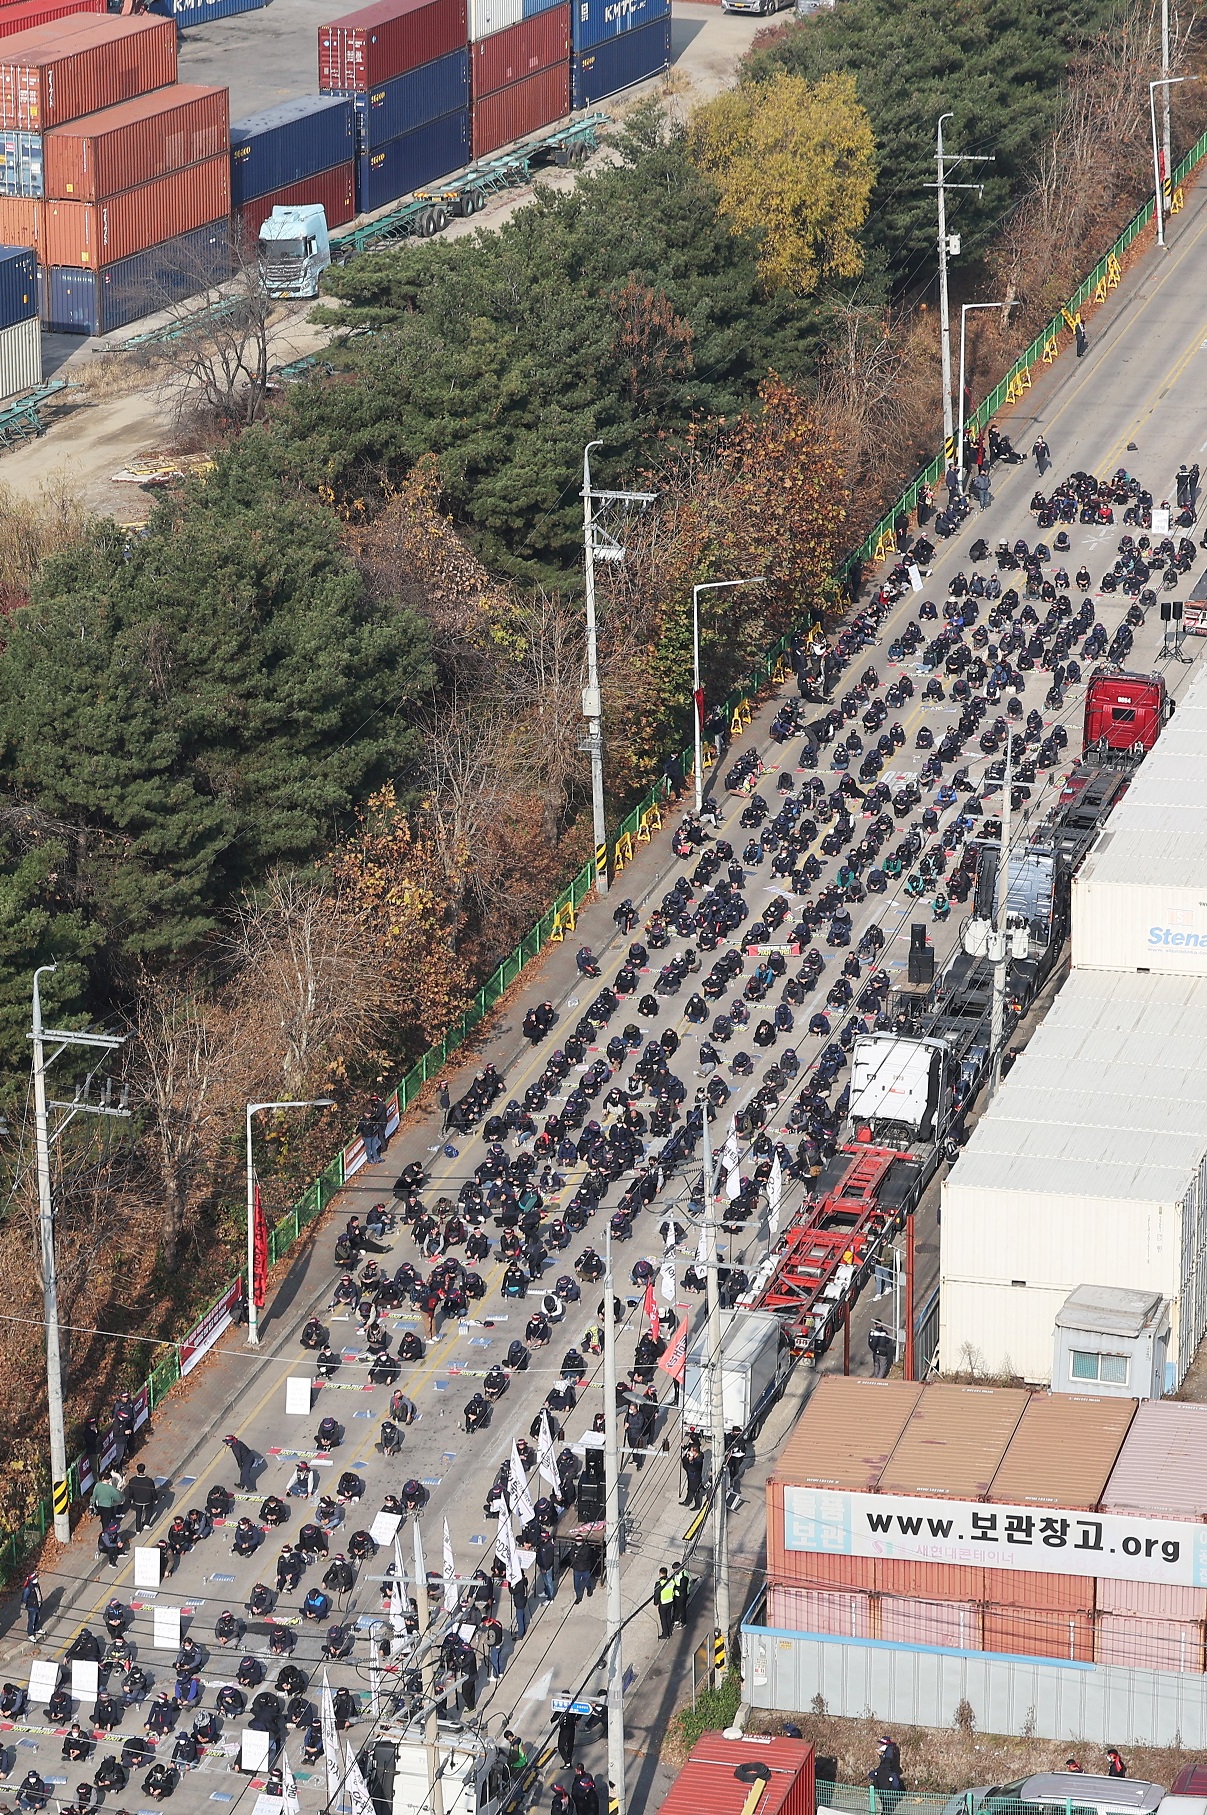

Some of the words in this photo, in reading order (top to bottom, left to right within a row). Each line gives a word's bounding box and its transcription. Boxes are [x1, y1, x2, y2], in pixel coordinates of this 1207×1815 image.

[792, 1521, 846, 1550] 보관
[866, 1511, 1180, 1563] www.보관창고.org
[916, 1544, 1015, 1565] 새현대콘테이너
